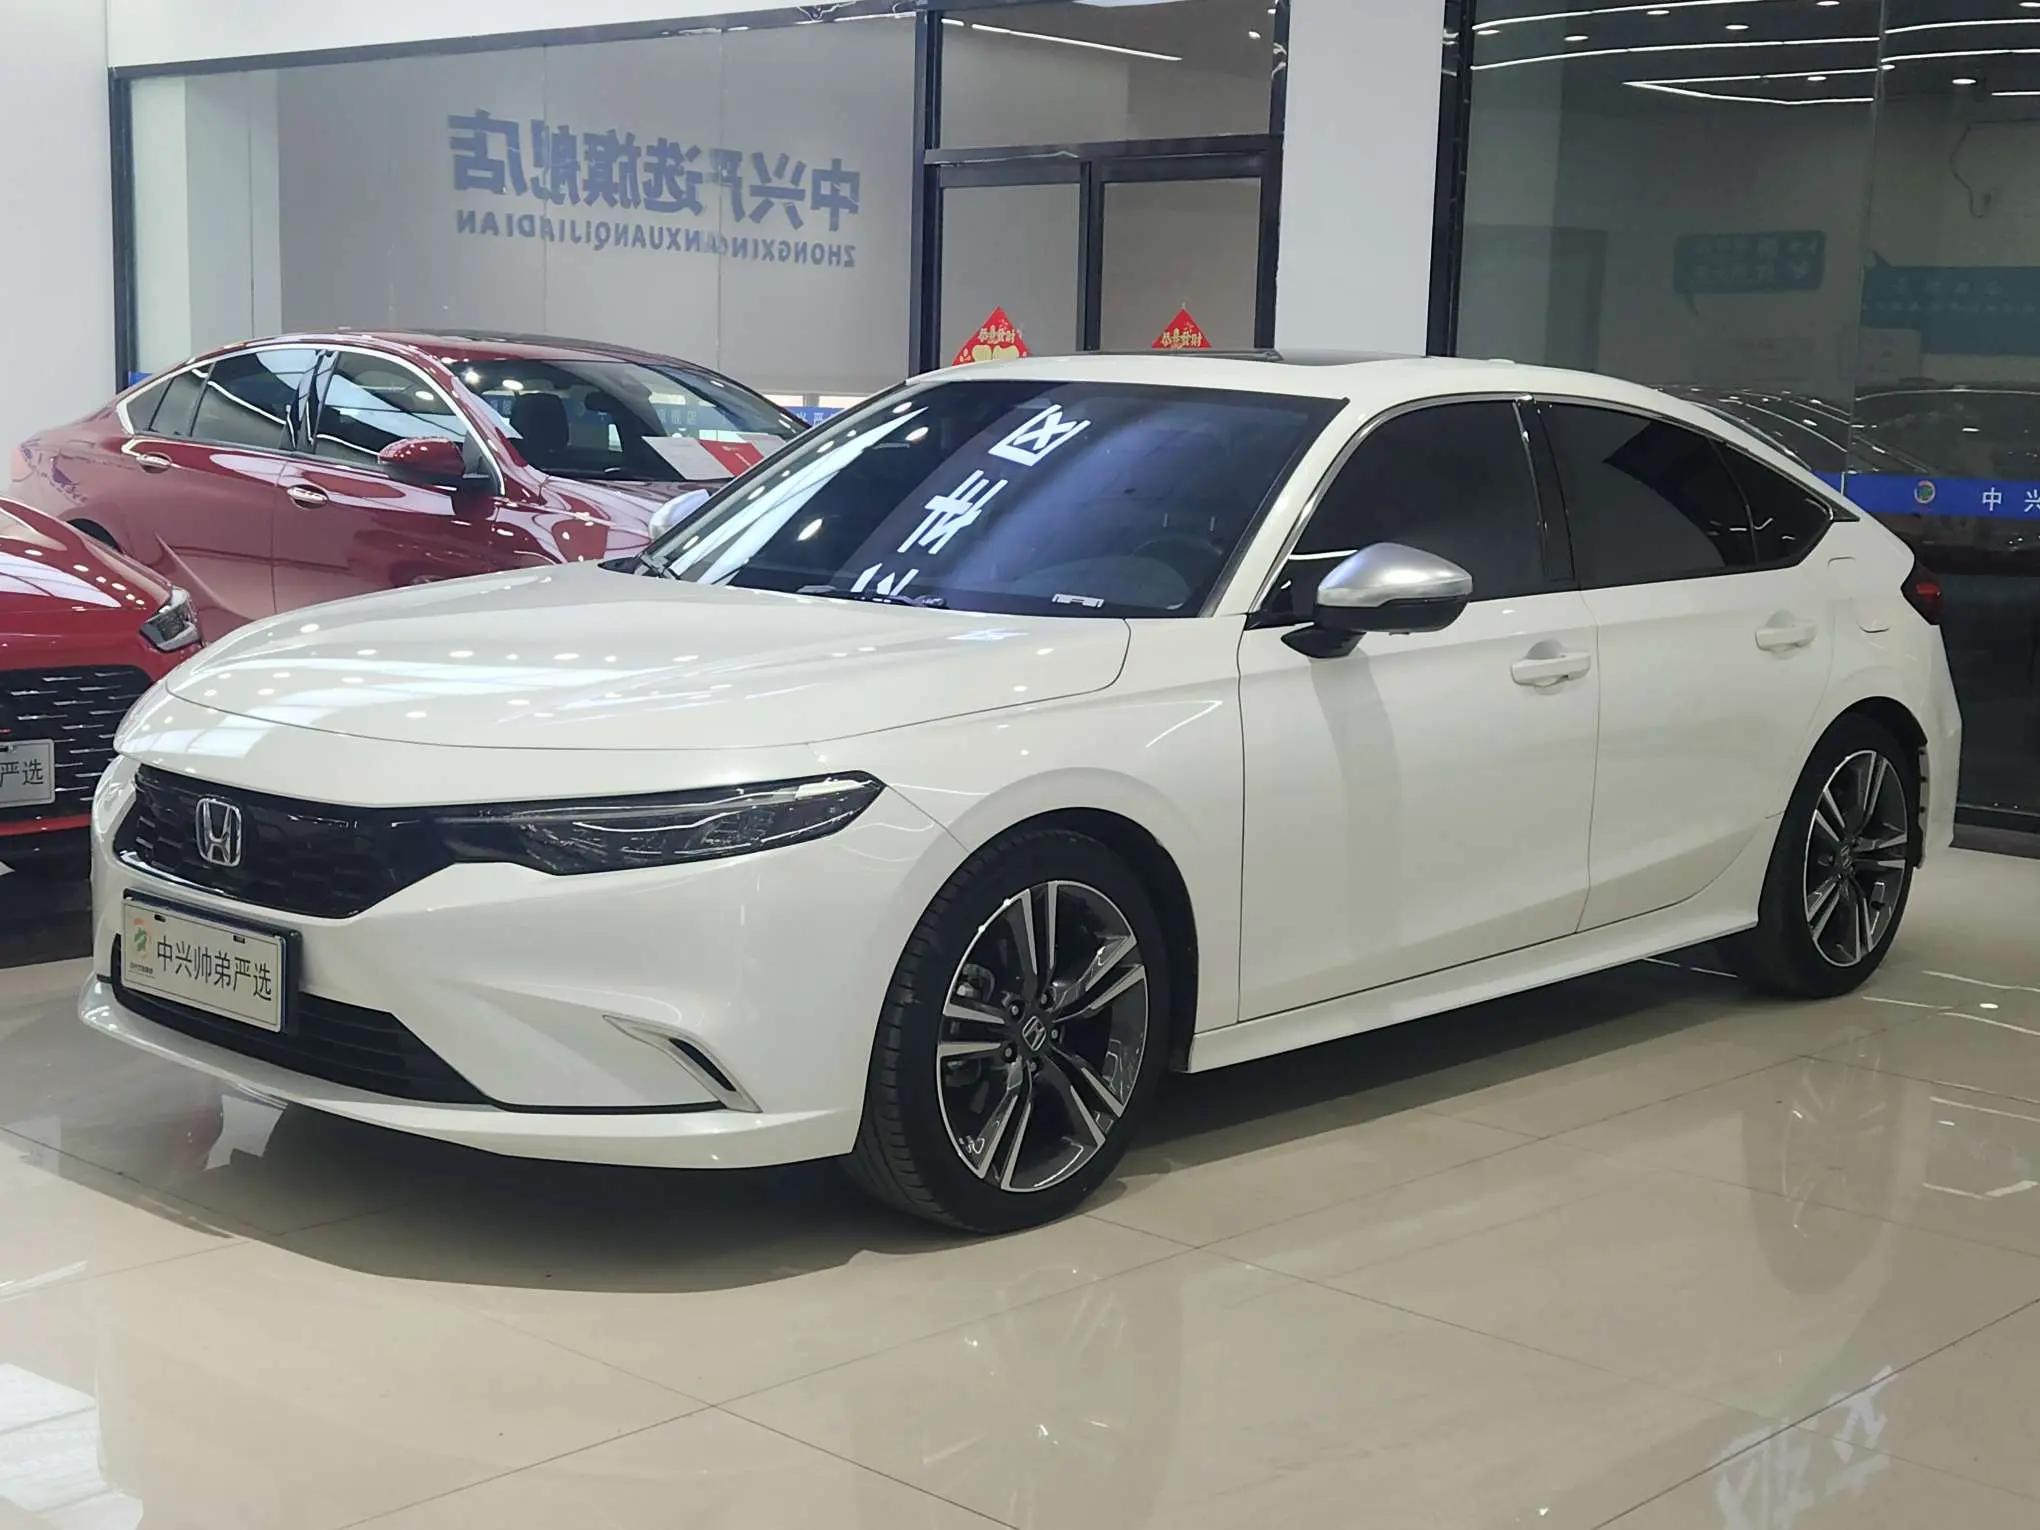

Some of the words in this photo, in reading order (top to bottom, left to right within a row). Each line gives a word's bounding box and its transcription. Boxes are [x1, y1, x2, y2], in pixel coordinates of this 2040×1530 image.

[157, 935, 272, 1001] 中兴帅弟严选
